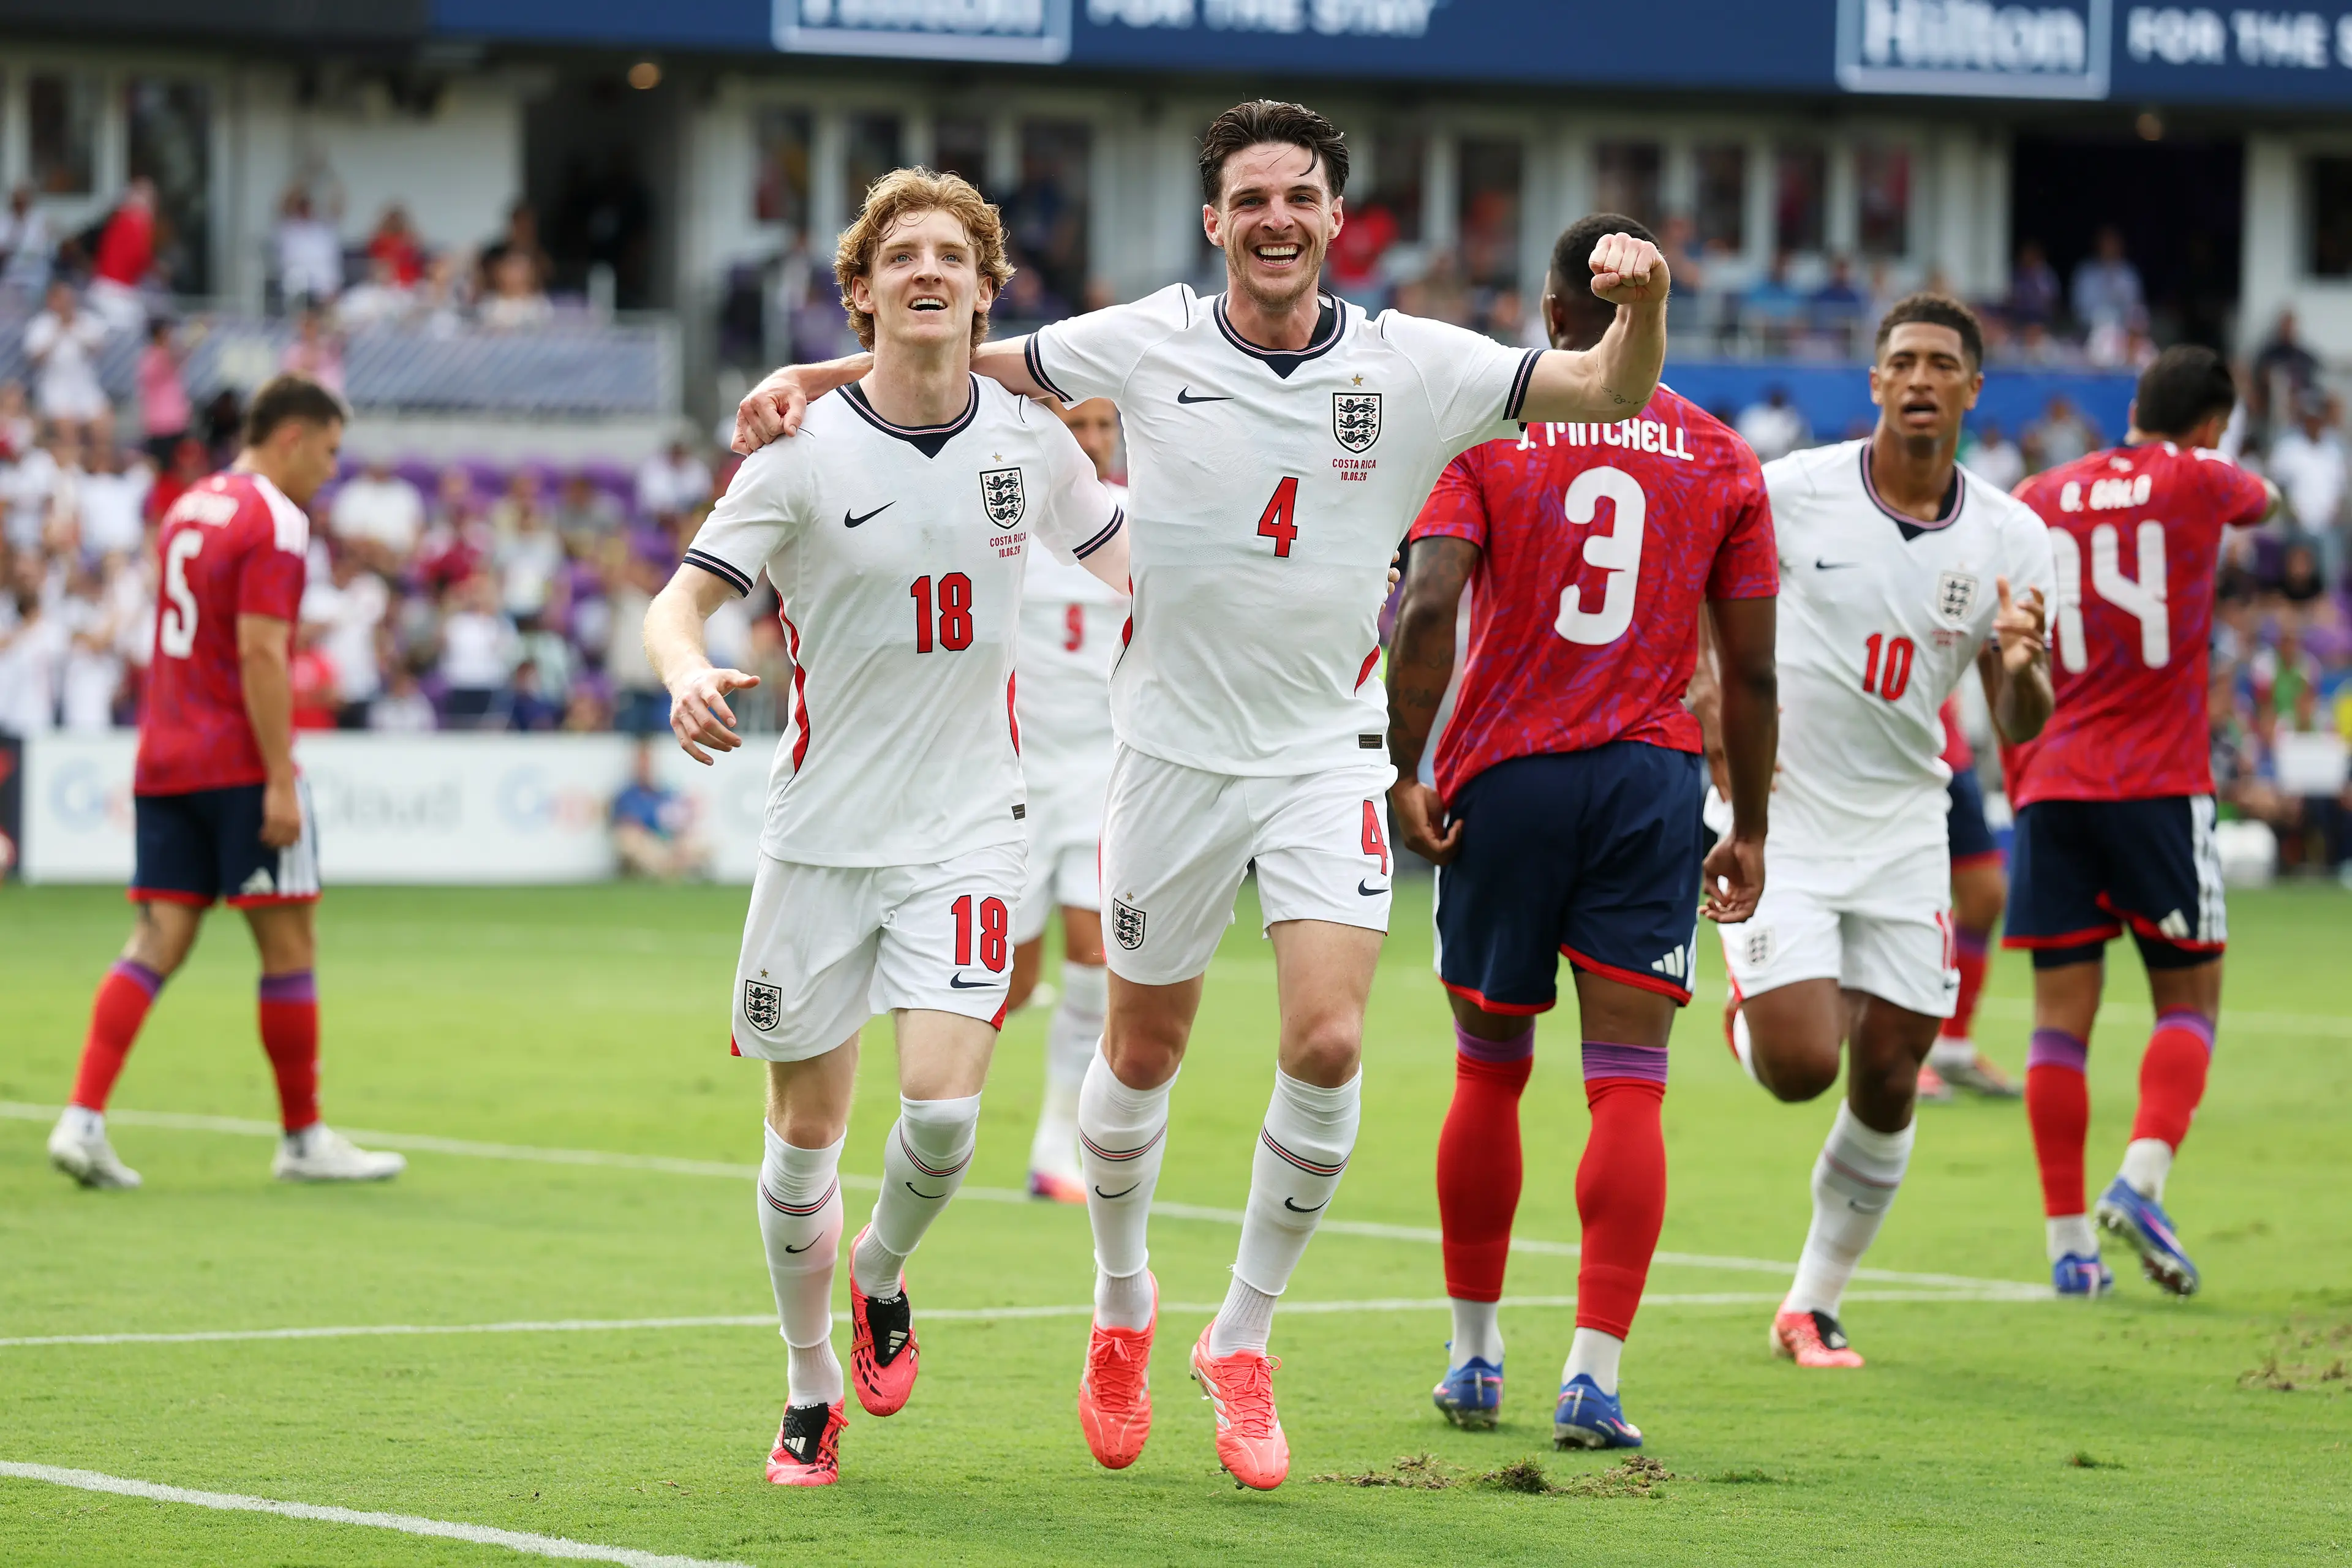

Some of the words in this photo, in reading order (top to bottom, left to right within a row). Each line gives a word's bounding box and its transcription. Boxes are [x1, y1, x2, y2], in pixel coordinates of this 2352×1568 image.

[2127, 7, 2226, 64] FOR
[1332, 458, 1359, 469] COSTA
[1361, 459, 1376, 469] RICA
[1545, 418, 1694, 461] MITCHELL
[1341, 471, 1367, 481] 10.06.26
[990, 535, 1012, 547] COSTA
[1014, 532, 1027, 543] RICA
[1257, 476, 1298, 558] 4
[998, 545, 1020, 558] 10.06.26
[1554, 466, 1646, 646] 3
[160, 528, 203, 659] 5
[910, 572, 973, 654] 18
[1063, 602, 1085, 654] 9
[1863, 632, 1915, 701] 10
[1361, 799, 1388, 876] 4
[951, 894, 1008, 973] 18
